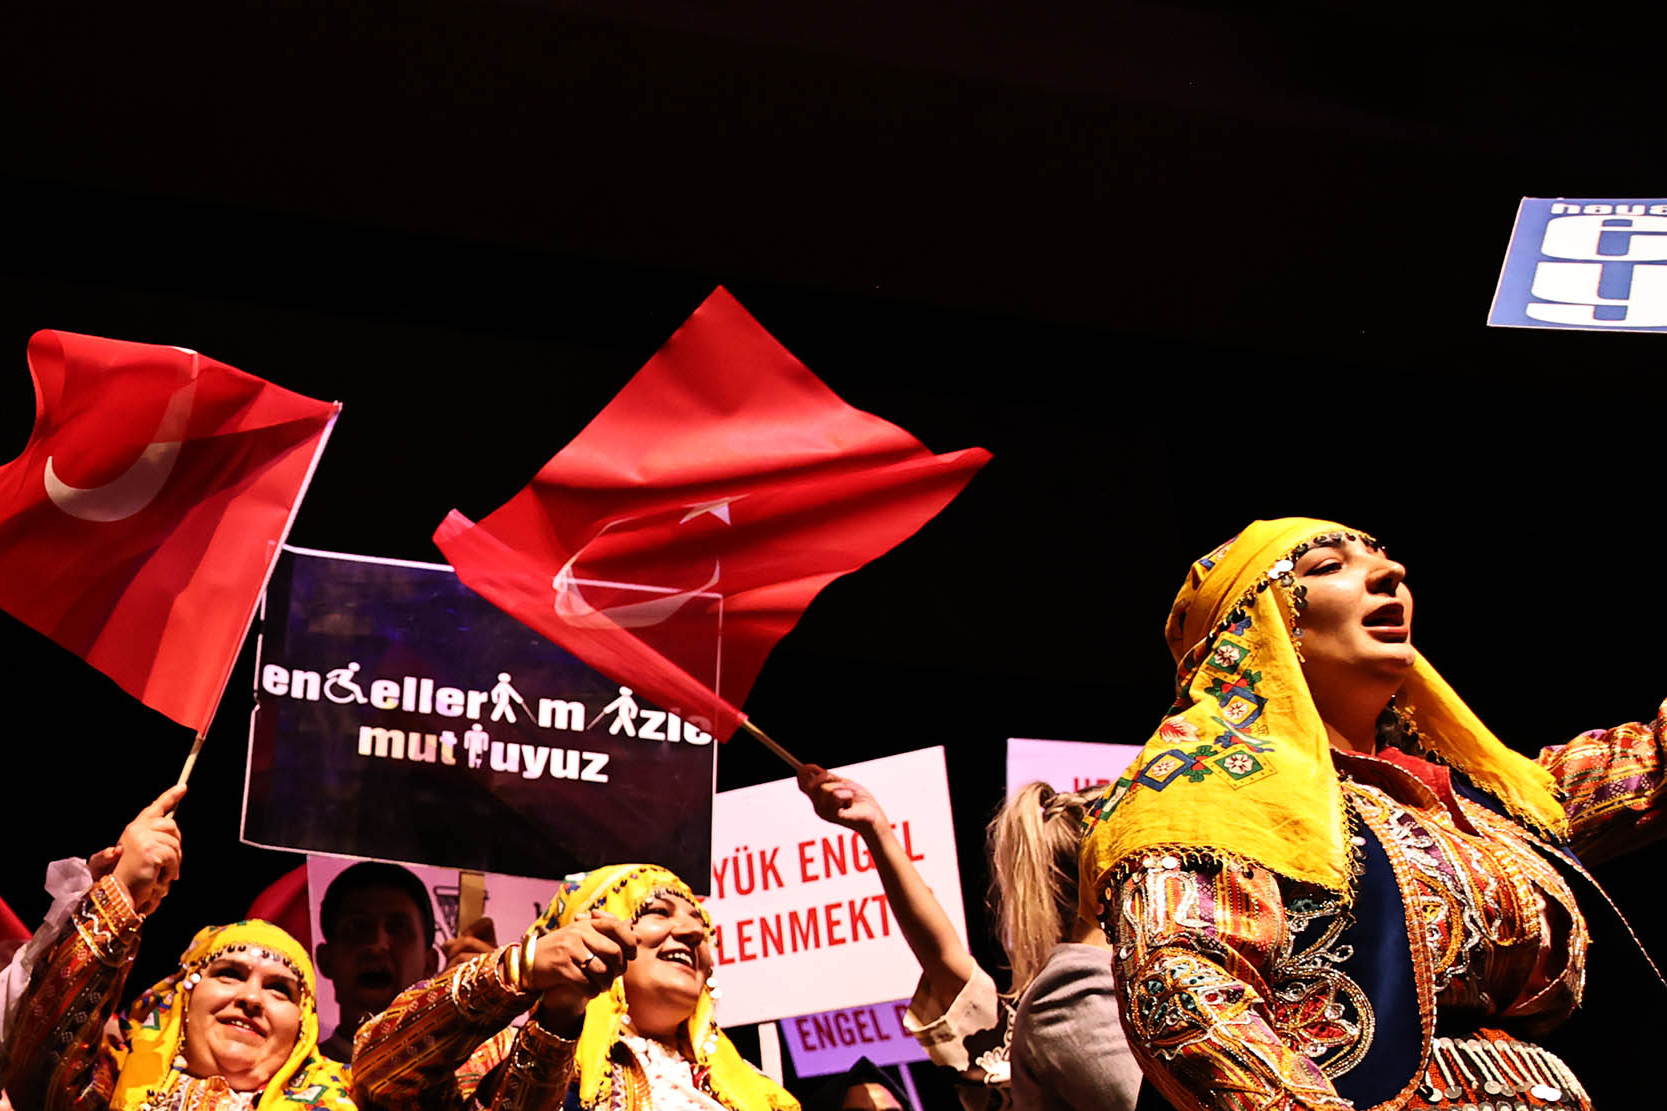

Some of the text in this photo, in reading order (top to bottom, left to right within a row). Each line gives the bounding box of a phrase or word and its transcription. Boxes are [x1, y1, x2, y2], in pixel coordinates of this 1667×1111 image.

[712, 820, 925, 900] YÜK ENGL
[795, 1008, 892, 1051] ENGEL
